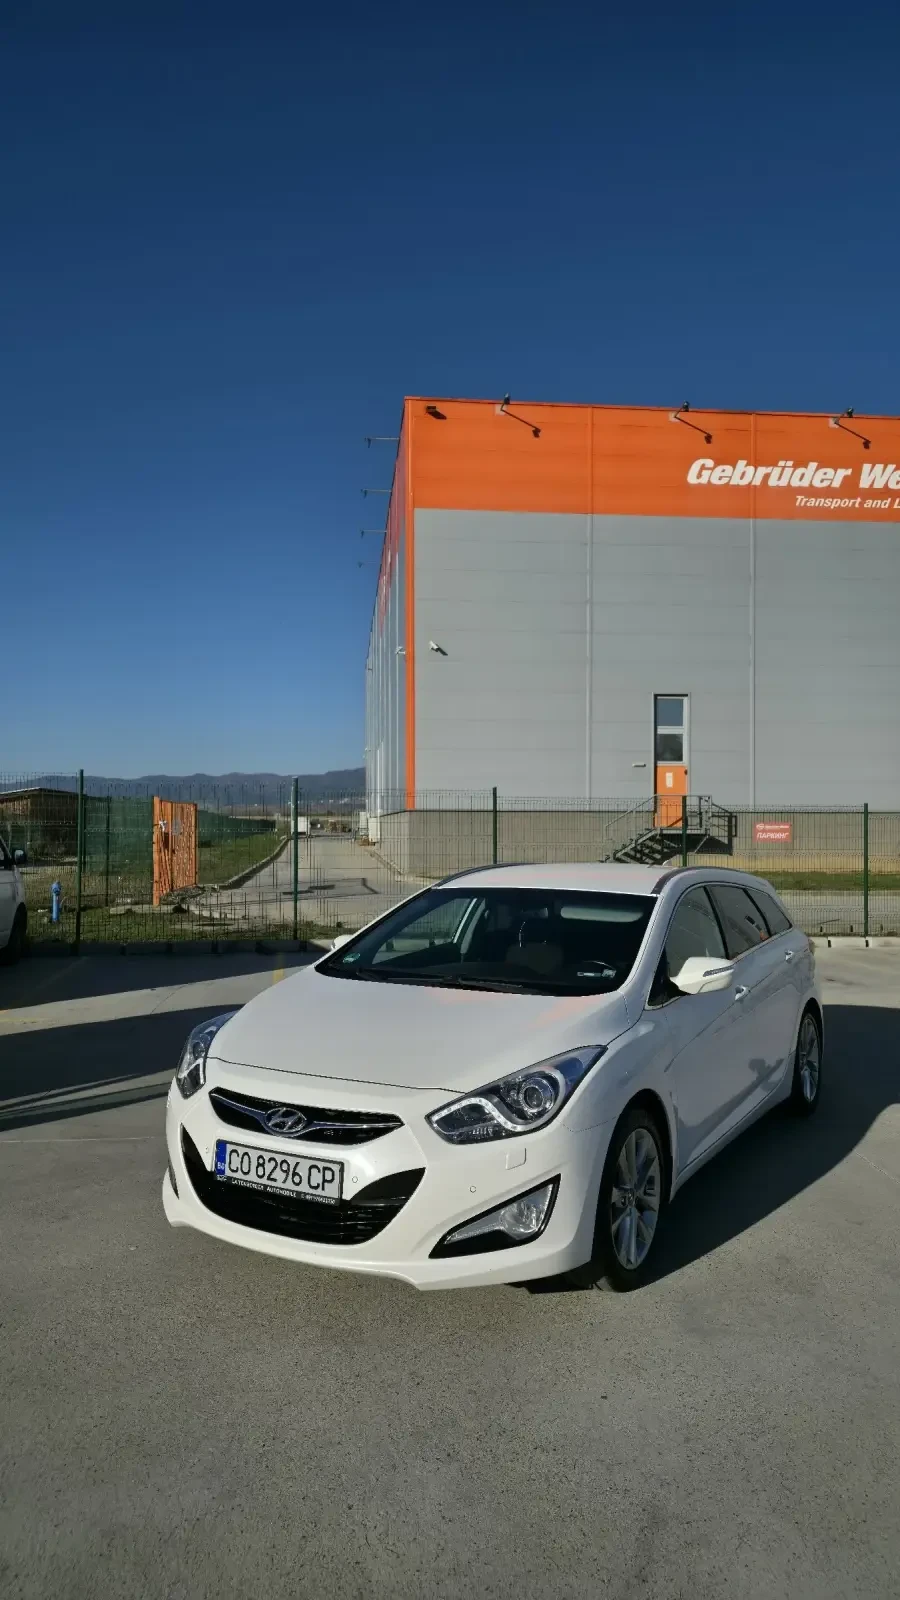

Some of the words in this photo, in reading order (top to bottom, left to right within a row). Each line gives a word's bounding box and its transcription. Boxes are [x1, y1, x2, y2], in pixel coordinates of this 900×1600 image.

[687, 458, 852, 488] Gebrüder
[796, 495, 861, 509] Transport
[864, 497, 891, 509] and
[228, 1149, 251, 1175] CO
[256, 1155, 302, 1186] 8296
[308, 1164, 335, 1191] CP
